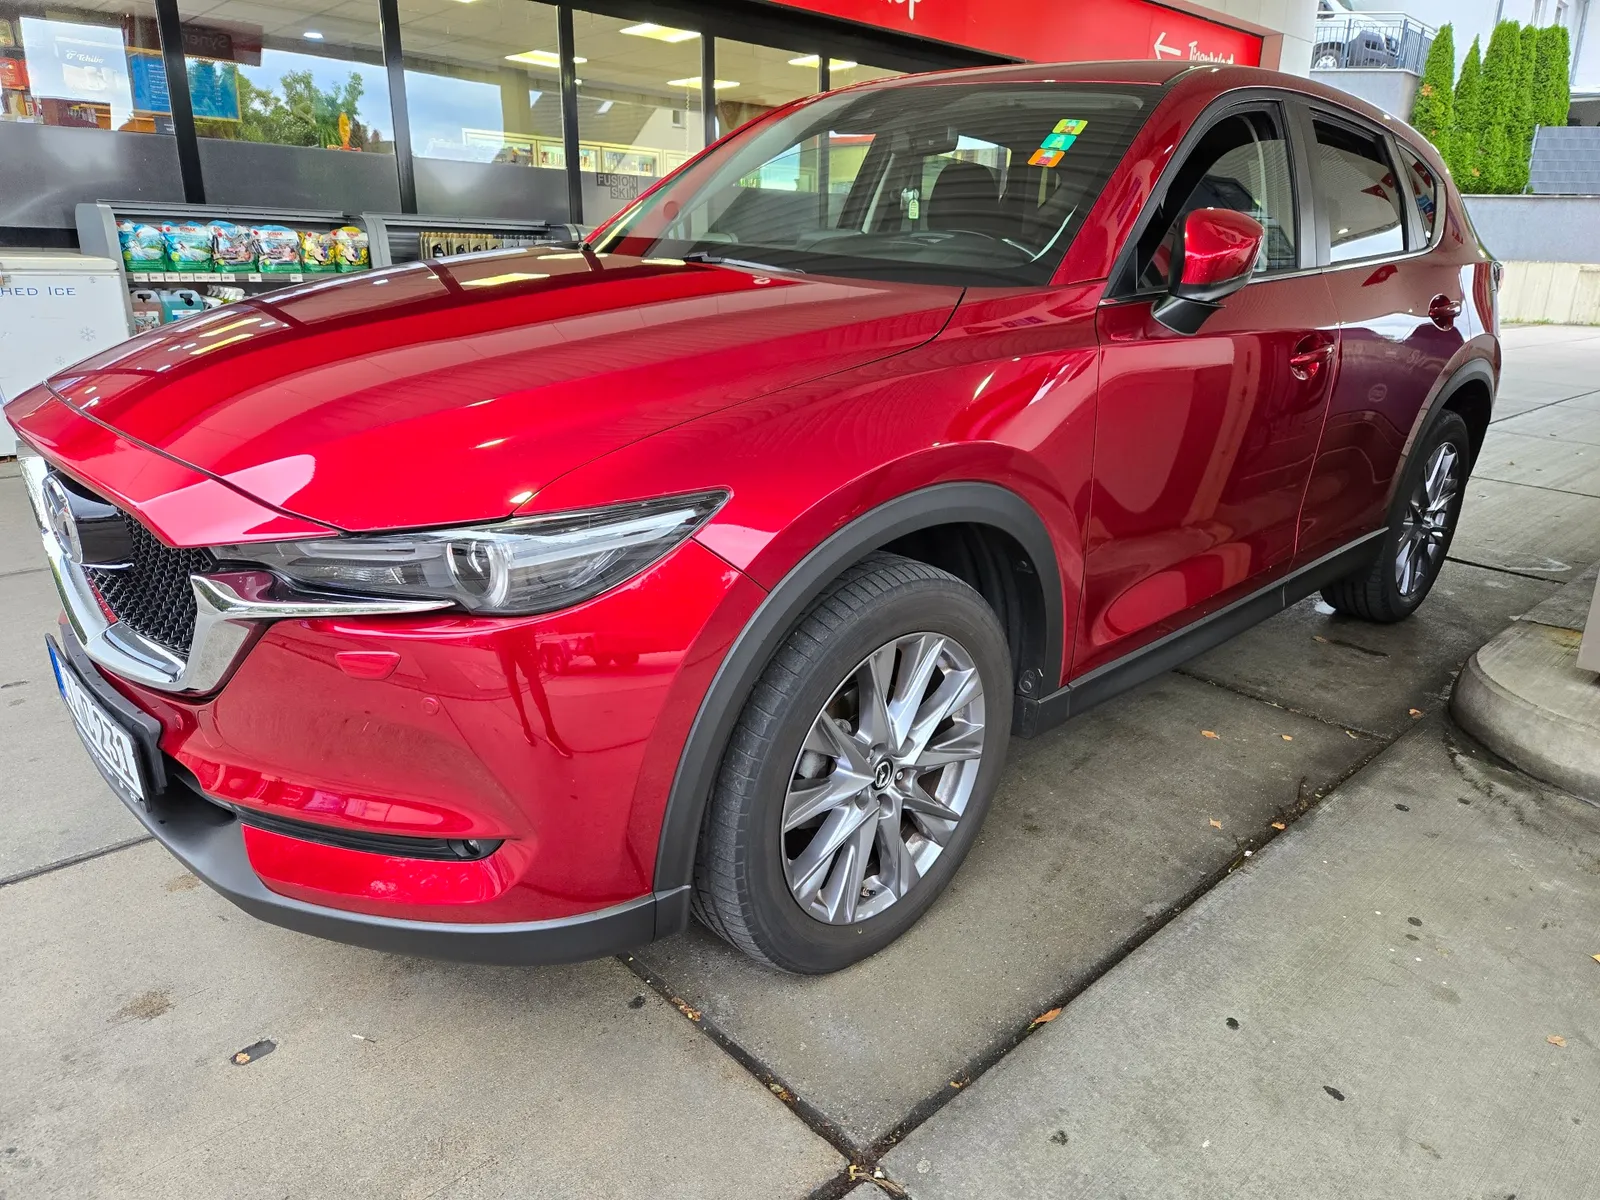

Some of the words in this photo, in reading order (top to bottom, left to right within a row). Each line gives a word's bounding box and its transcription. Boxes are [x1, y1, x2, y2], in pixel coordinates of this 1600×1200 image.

[77, 54, 104, 64] Tchibo
[597, 174, 637, 187] FUSION
[611, 187, 637, 199] SKIN
[48, 286, 76, 296] ICE
